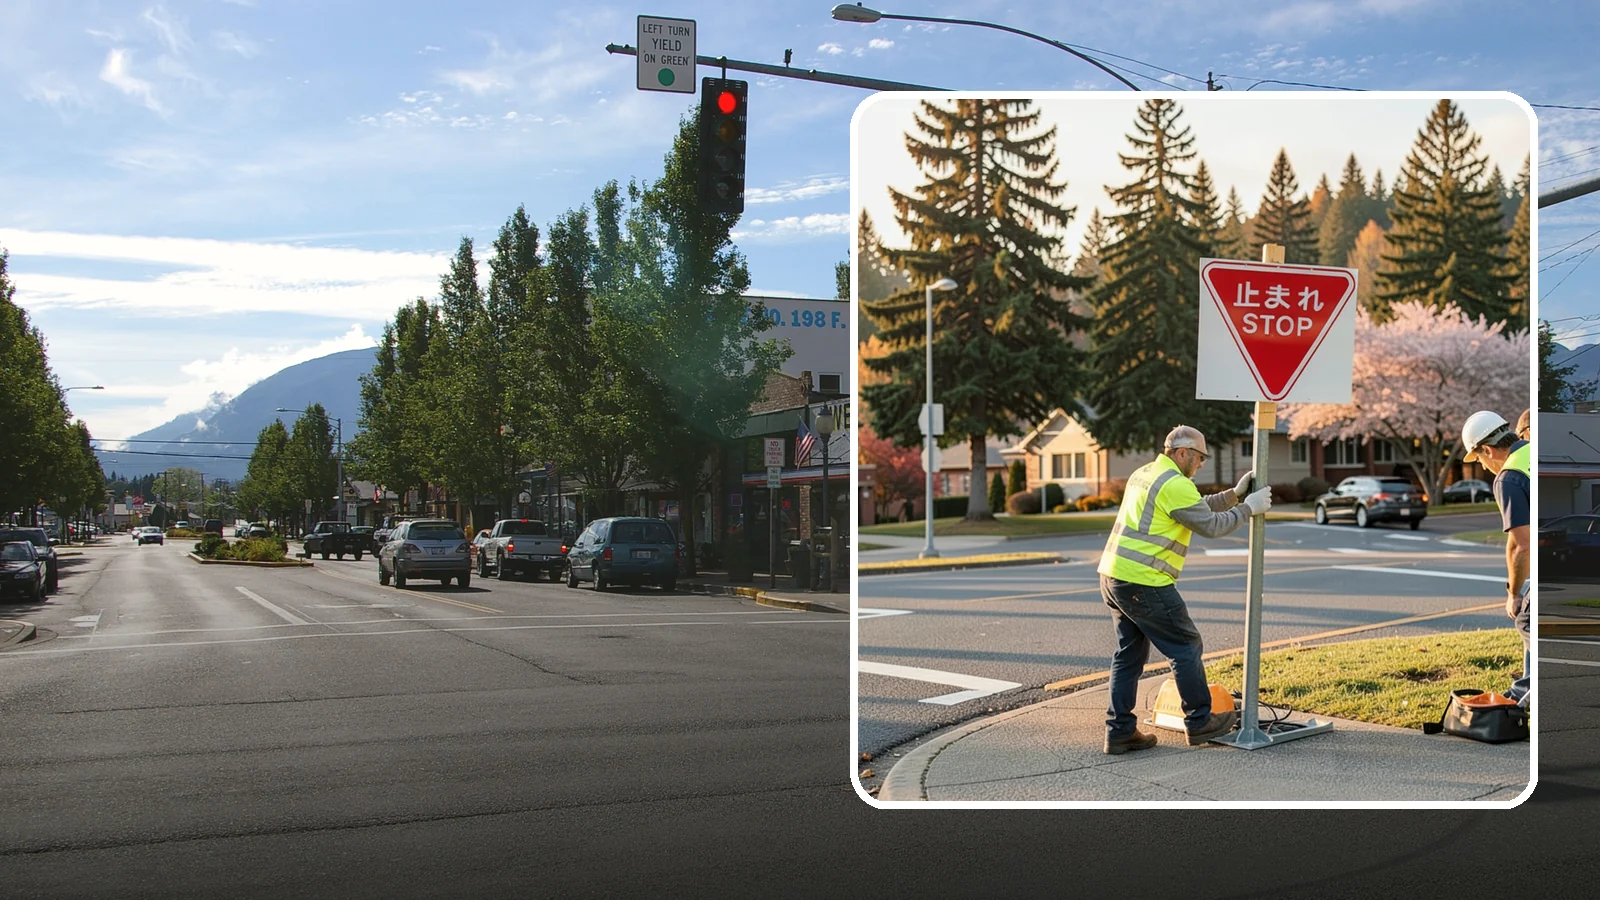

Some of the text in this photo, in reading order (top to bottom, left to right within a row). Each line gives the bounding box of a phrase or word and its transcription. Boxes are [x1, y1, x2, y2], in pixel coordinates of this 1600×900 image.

[643, 24, 690, 36] LEFT TURN
[652, 38, 682, 52] YIELD
[644, 53, 689, 66] ON GREEN
[1233, 281, 1324, 312] 止まれ
[791, 309, 827, 328] 198
[1242, 313, 1313, 337] STOP
